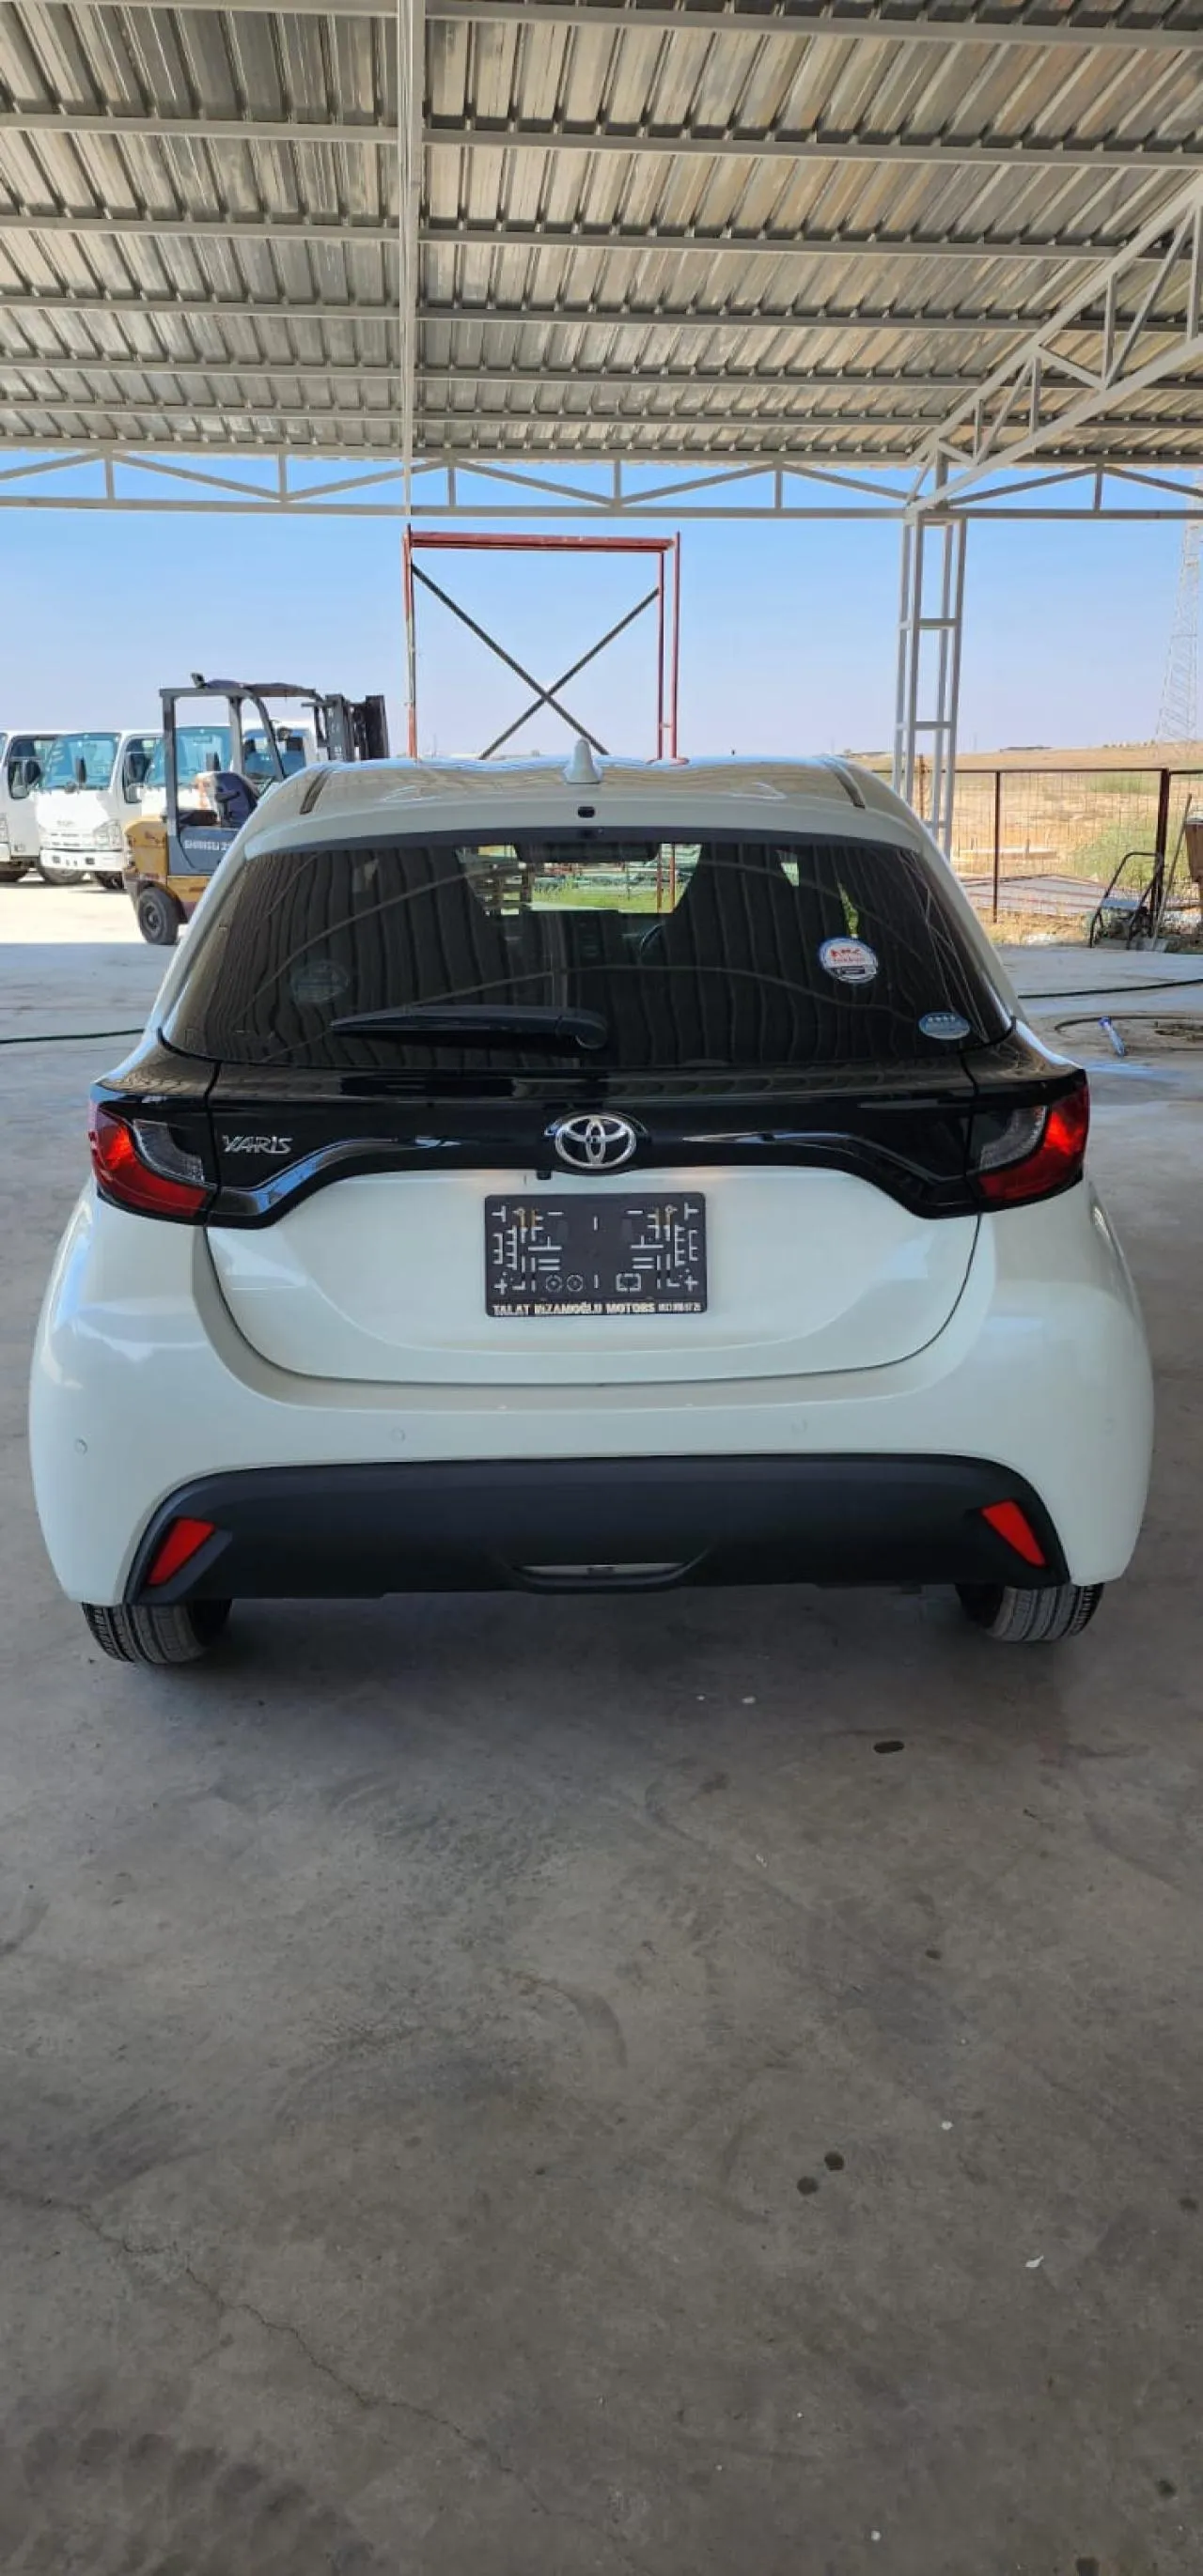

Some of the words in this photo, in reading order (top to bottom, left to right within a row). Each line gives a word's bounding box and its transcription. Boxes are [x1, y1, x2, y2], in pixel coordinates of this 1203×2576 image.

[222, 1135, 292, 1154] YARIS
[492, 1304, 529, 1315] TALAT
[606, 1302, 655, 1314] MOTORS
